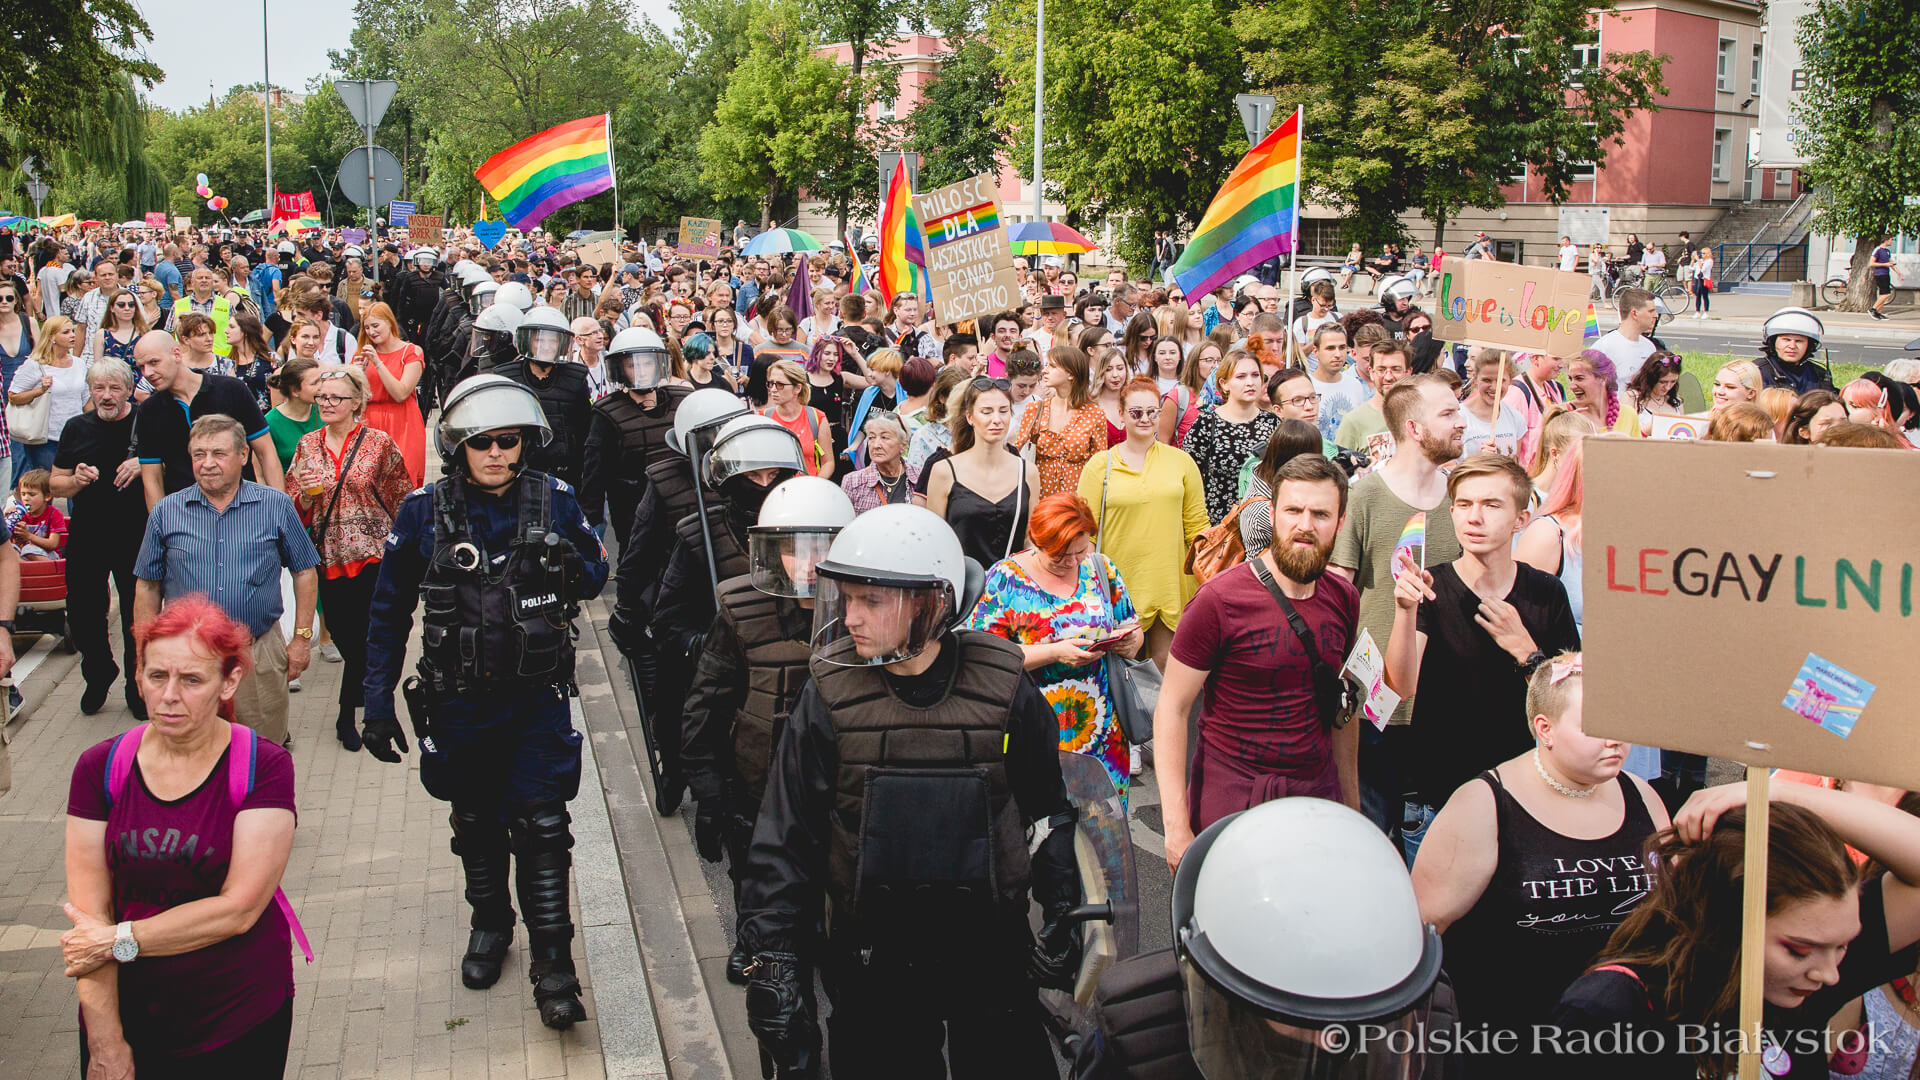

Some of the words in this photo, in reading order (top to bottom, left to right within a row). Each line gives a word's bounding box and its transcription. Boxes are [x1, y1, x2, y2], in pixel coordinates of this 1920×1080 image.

[919, 176, 988, 220] MIŁOŚĆ
[942, 210, 980, 242] DLA
[930, 232, 1001, 272] WSZYSTKICH
[947, 261, 995, 294] PONAD
[942, 285, 1008, 321] WSZYSTKO
[1500, 306, 1514, 327] is
[1605, 545, 1913, 618] LEGAYLNI
[1553, 855, 1645, 874] LOVE
[1522, 877, 1598, 899] THE
[1606, 873, 1659, 893] LIF
[1516, 913, 1601, 928] you
